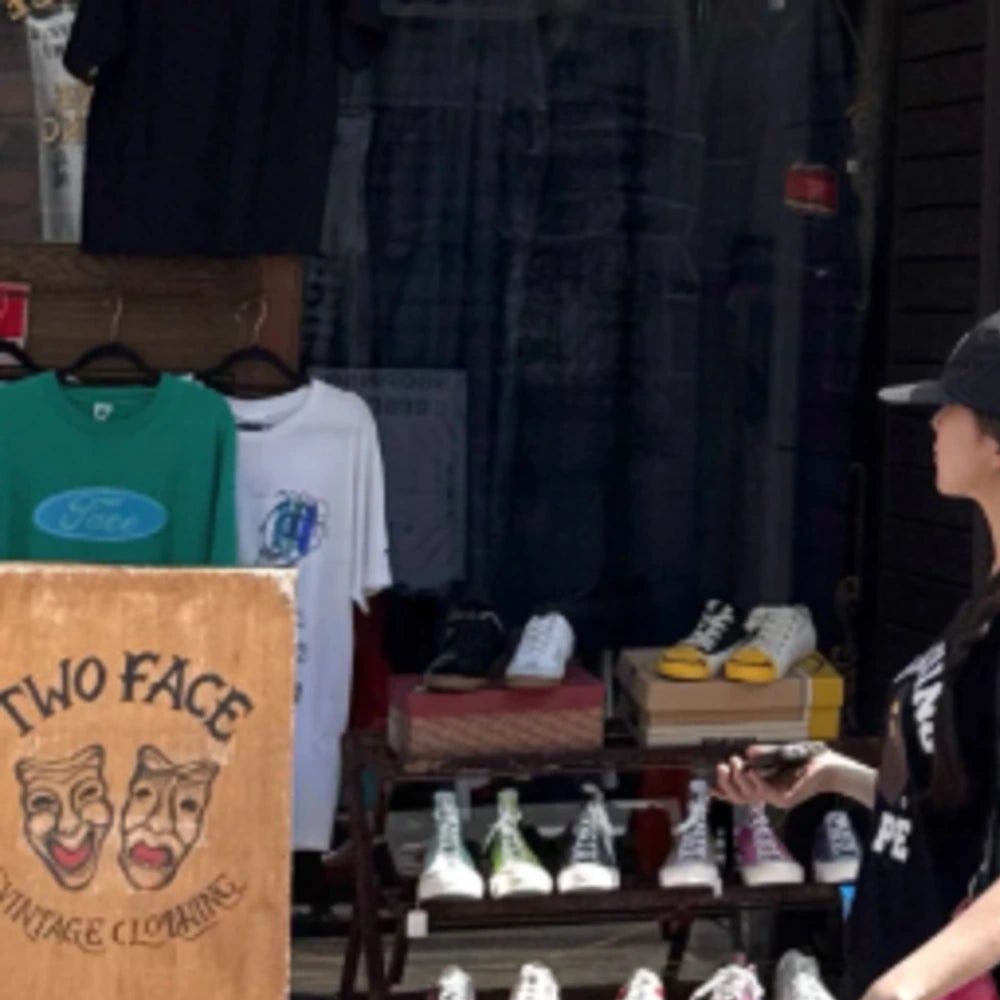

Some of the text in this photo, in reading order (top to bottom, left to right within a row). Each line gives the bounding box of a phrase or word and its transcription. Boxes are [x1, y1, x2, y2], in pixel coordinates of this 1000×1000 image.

[0, 654, 107, 737] TWO
[119, 650, 254, 742] FACE
[112, 873, 248, 946] CLOTHING
